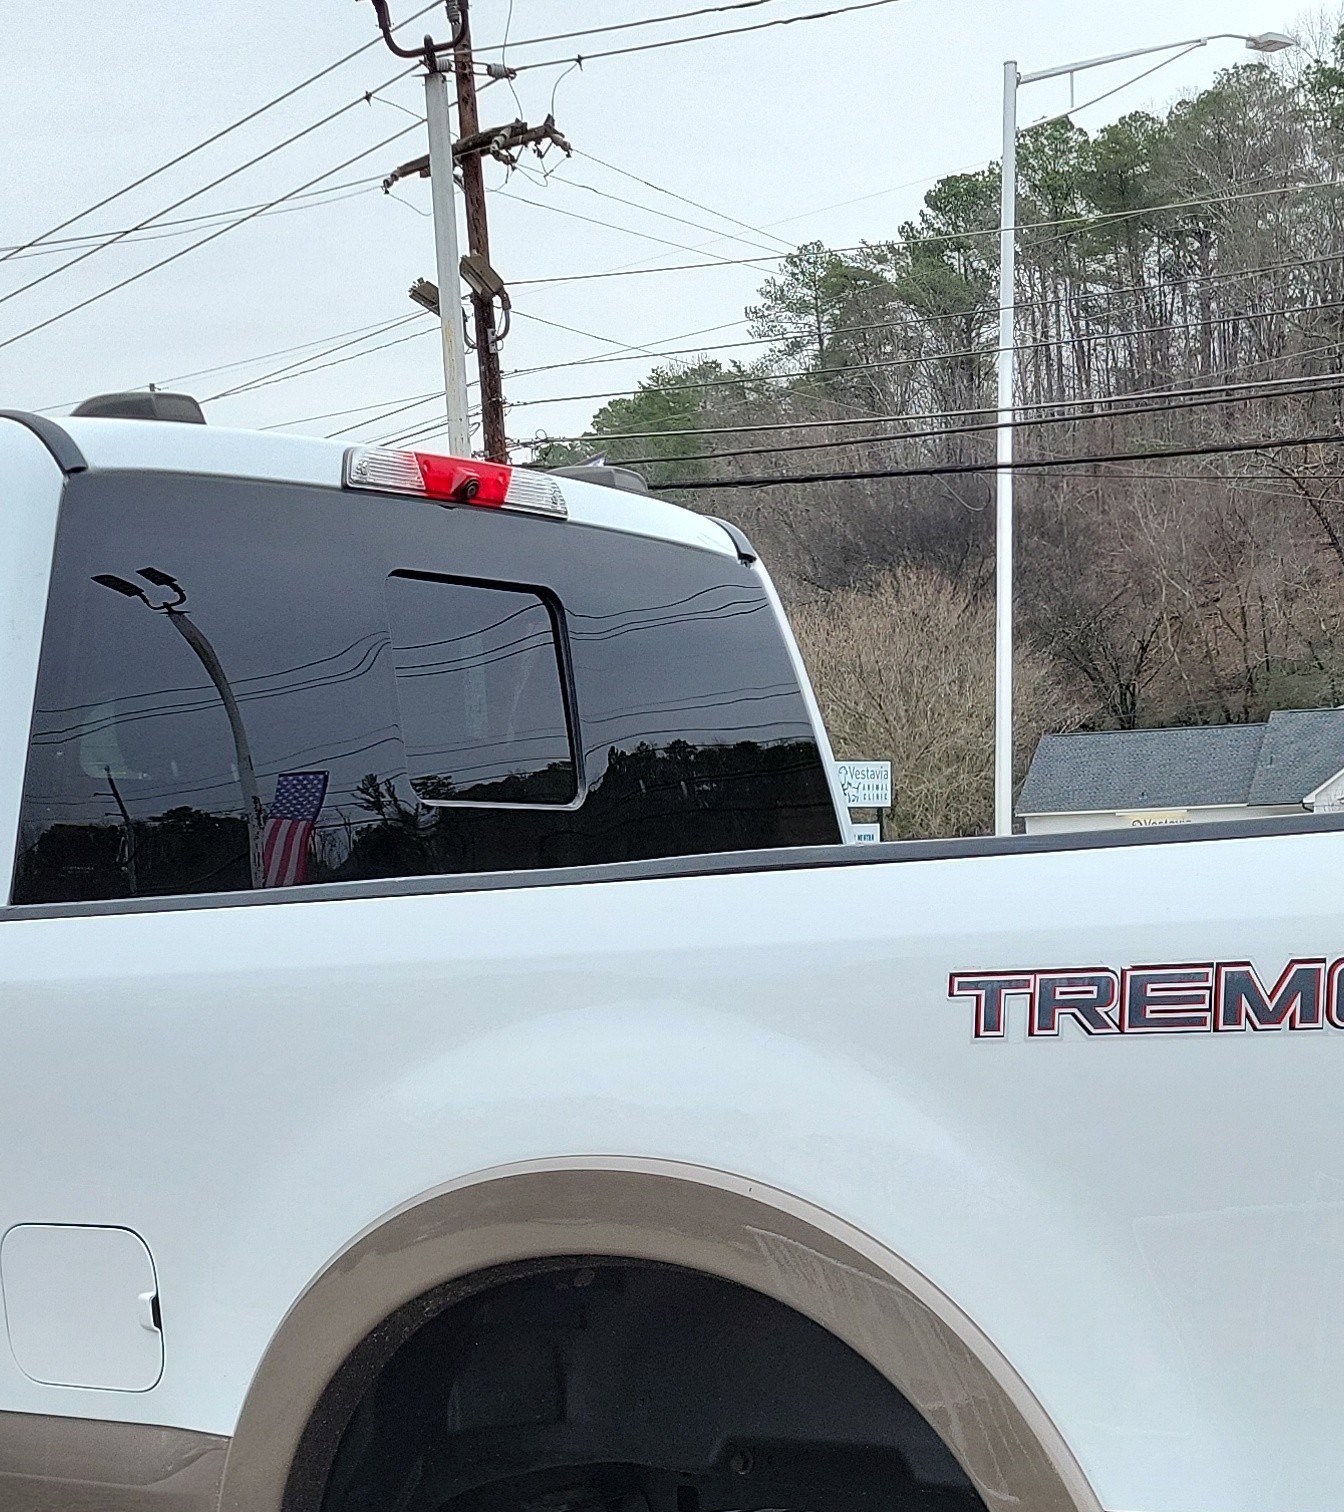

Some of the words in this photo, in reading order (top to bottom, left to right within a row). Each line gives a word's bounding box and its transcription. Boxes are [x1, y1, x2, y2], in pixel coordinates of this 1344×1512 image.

[848, 766, 889, 780] Vestavia
[862, 783, 888, 791] ANIMAL
[862, 793, 888, 801] CLINIC
